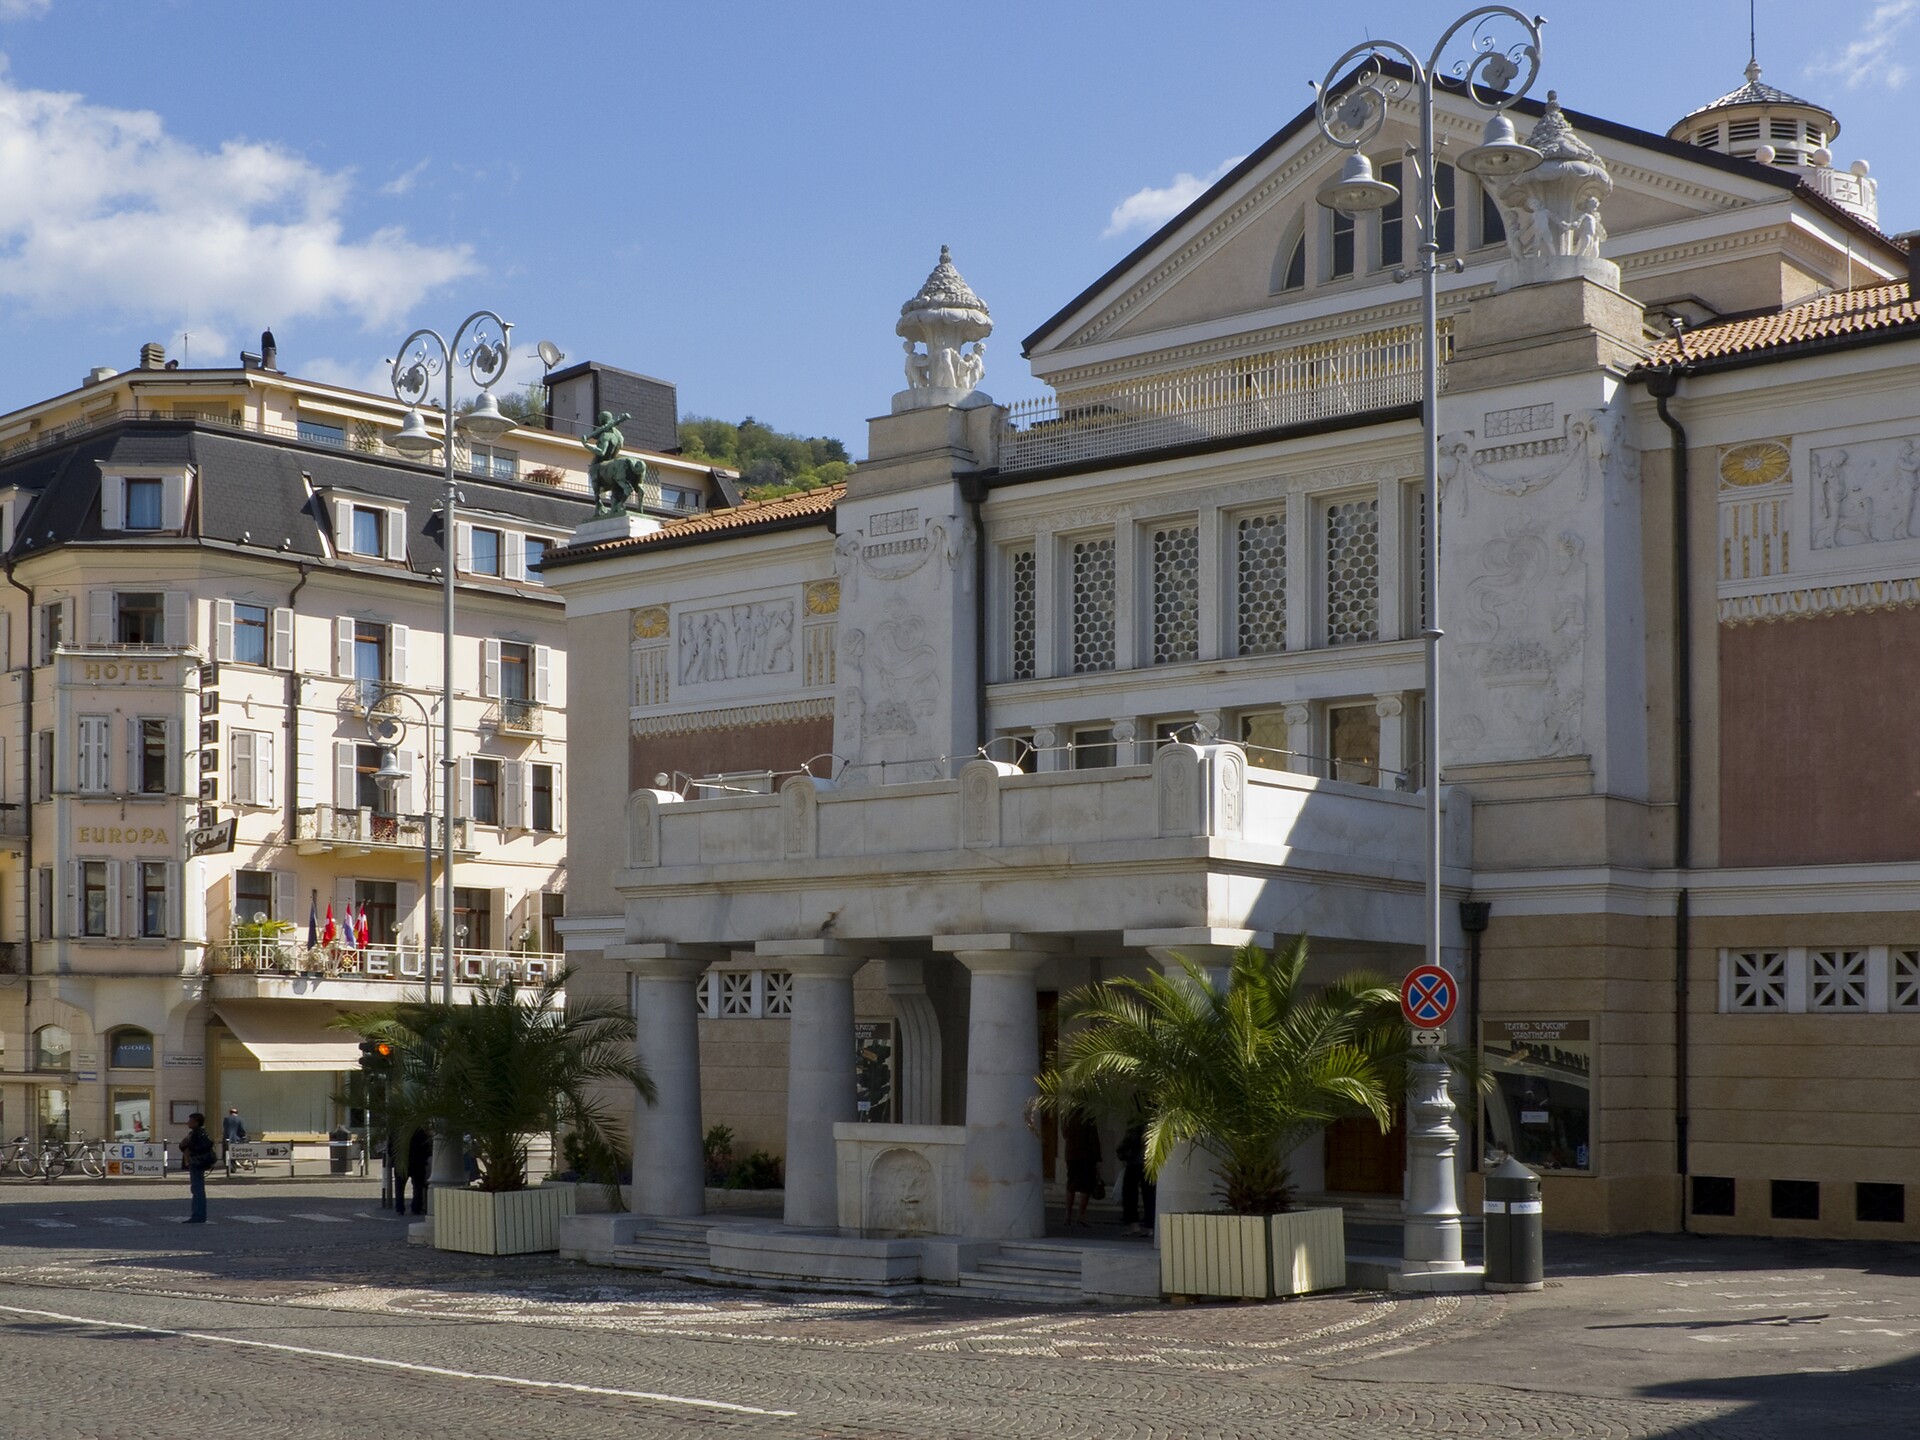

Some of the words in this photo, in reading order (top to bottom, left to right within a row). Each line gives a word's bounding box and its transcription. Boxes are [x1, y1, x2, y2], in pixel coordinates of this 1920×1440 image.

[85, 663, 163, 681] HOTEL
[200, 665, 213, 828] EUROPA
[78, 826, 169, 845] EUROPA
[1504, 1022, 1530, 1030] TEATRO
[124, 1147, 132, 1157] P
